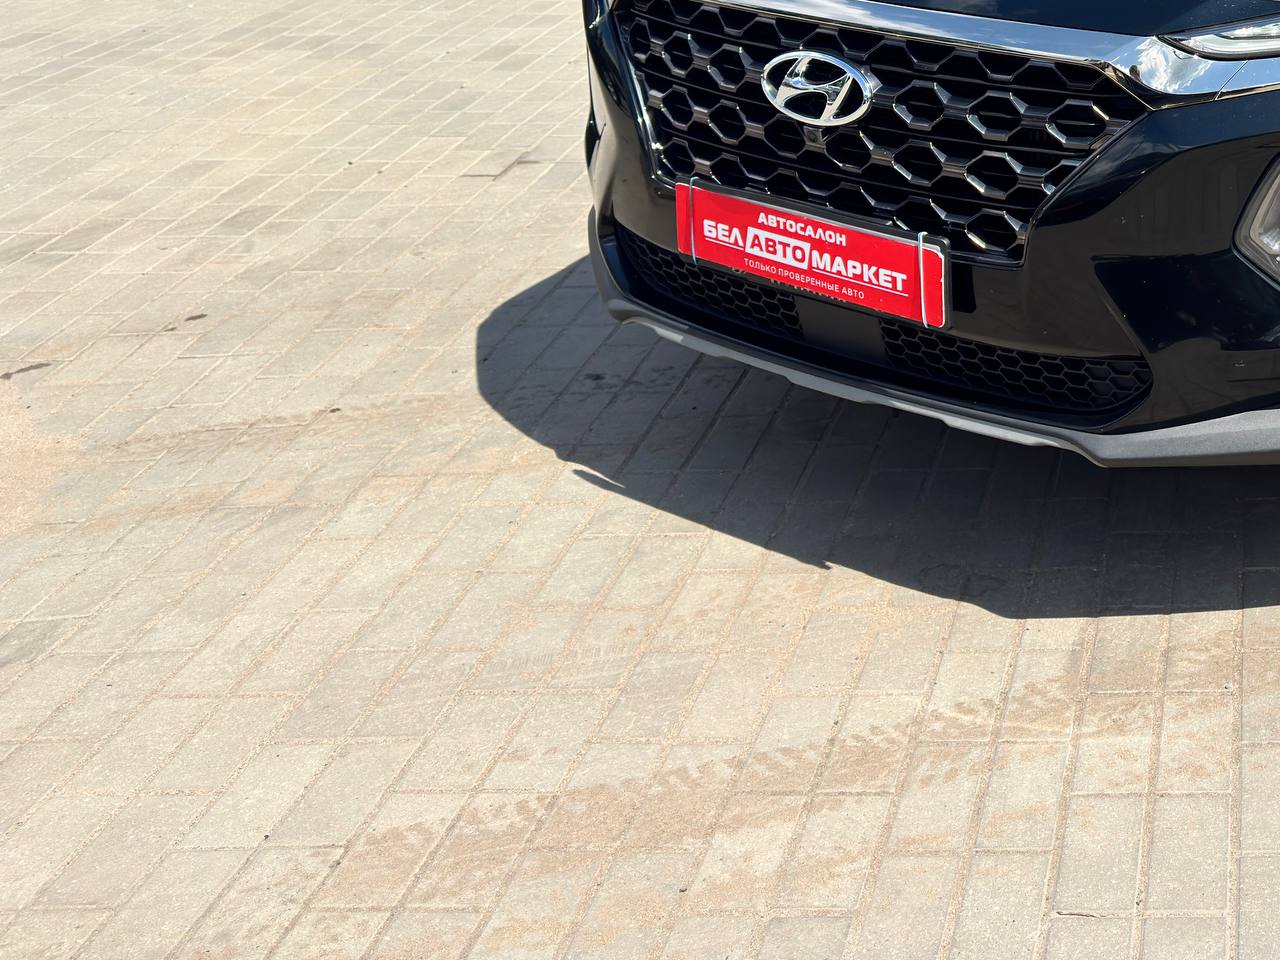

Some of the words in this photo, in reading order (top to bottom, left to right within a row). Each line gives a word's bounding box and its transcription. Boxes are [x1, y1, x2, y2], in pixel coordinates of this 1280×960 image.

[757, 211, 847, 246] АВТОСАЛОН
[703, 218, 744, 247] БЕЛ
[749, 231, 807, 264] АВТО
[811, 249, 908, 291] МАРКЕТ
[743, 257, 777, 275] ТОЛЬКО
[778, 268, 840, 293] ПРОВЕРЕННЫЕ
[841, 286, 866, 300] АВТО
